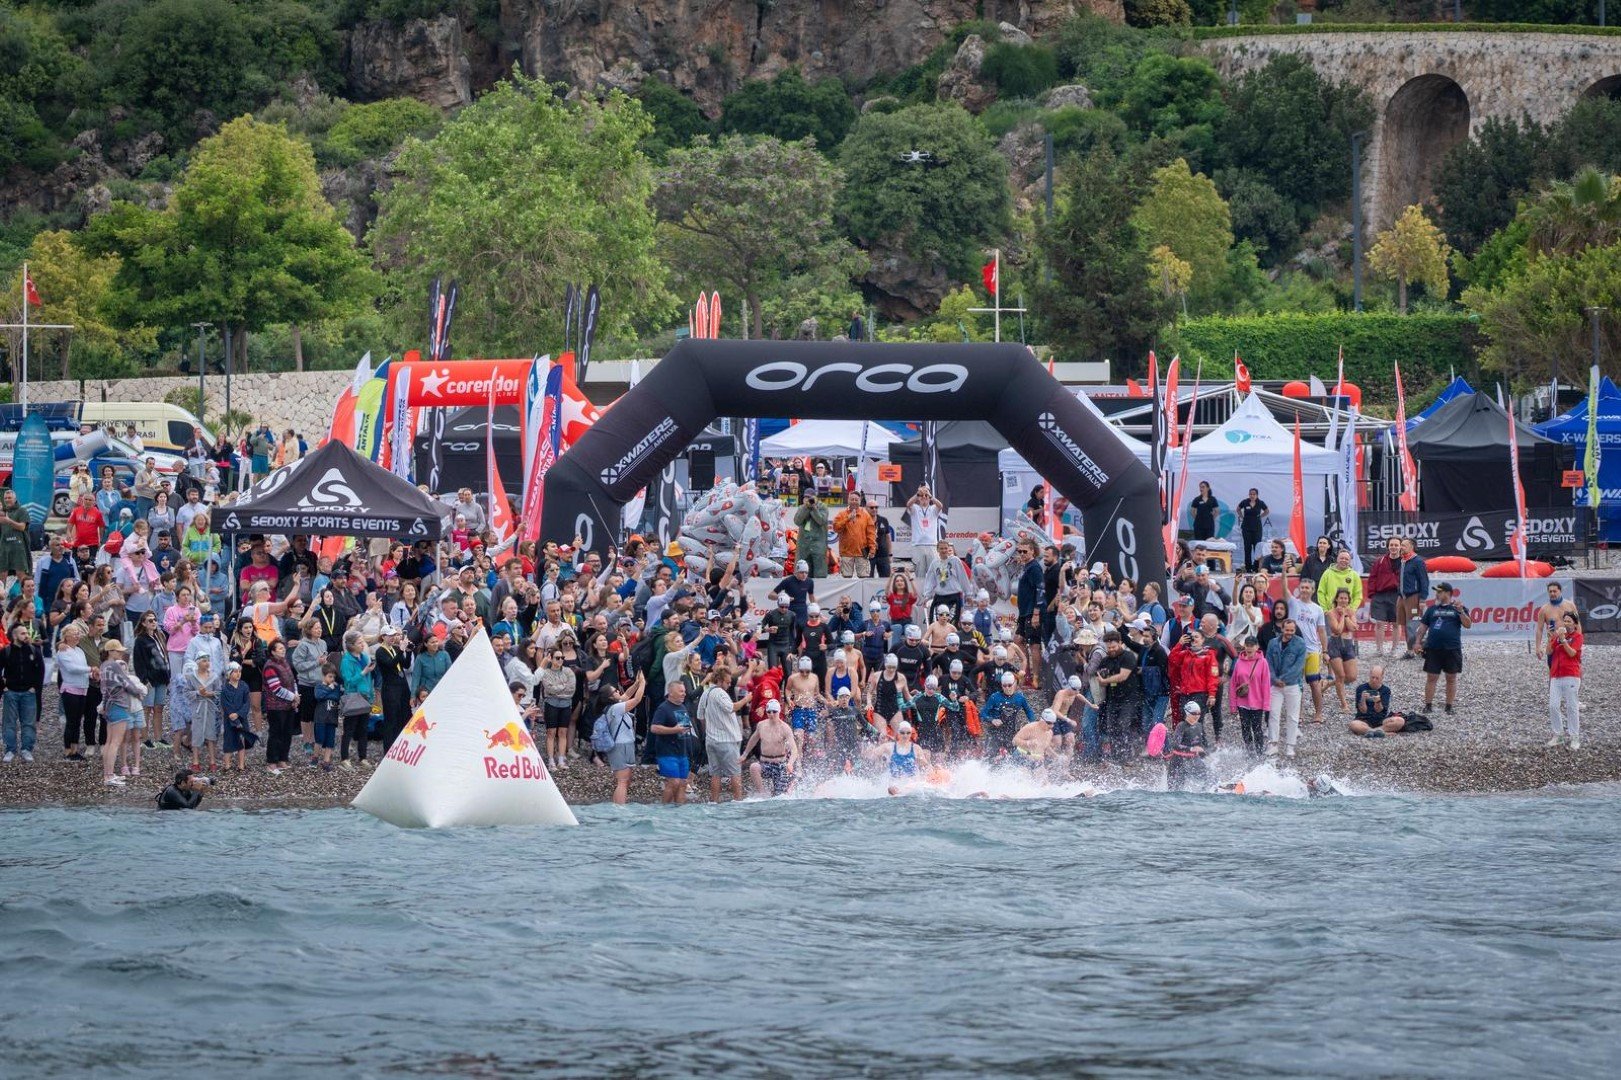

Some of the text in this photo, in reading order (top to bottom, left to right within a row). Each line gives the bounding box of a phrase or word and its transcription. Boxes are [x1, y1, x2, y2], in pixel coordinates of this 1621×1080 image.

[745, 361, 969, 393] orca
[361, 413, 370, 451] ANTALYA
[653, 424, 679, 449] ANTALYA
[1561, 432, 1621, 443] X-WERS
[1077, 465, 1101, 490] ANTALYA
[251, 516, 400, 531] SEDOXY SPORTS EVENTS
[1368, 522, 1440, 540] SEDOXY
[1368, 540, 1387, 549] SPO
[1541, 534, 1576, 543] EVENTS
[484, 755, 547, 781] Red Bull
